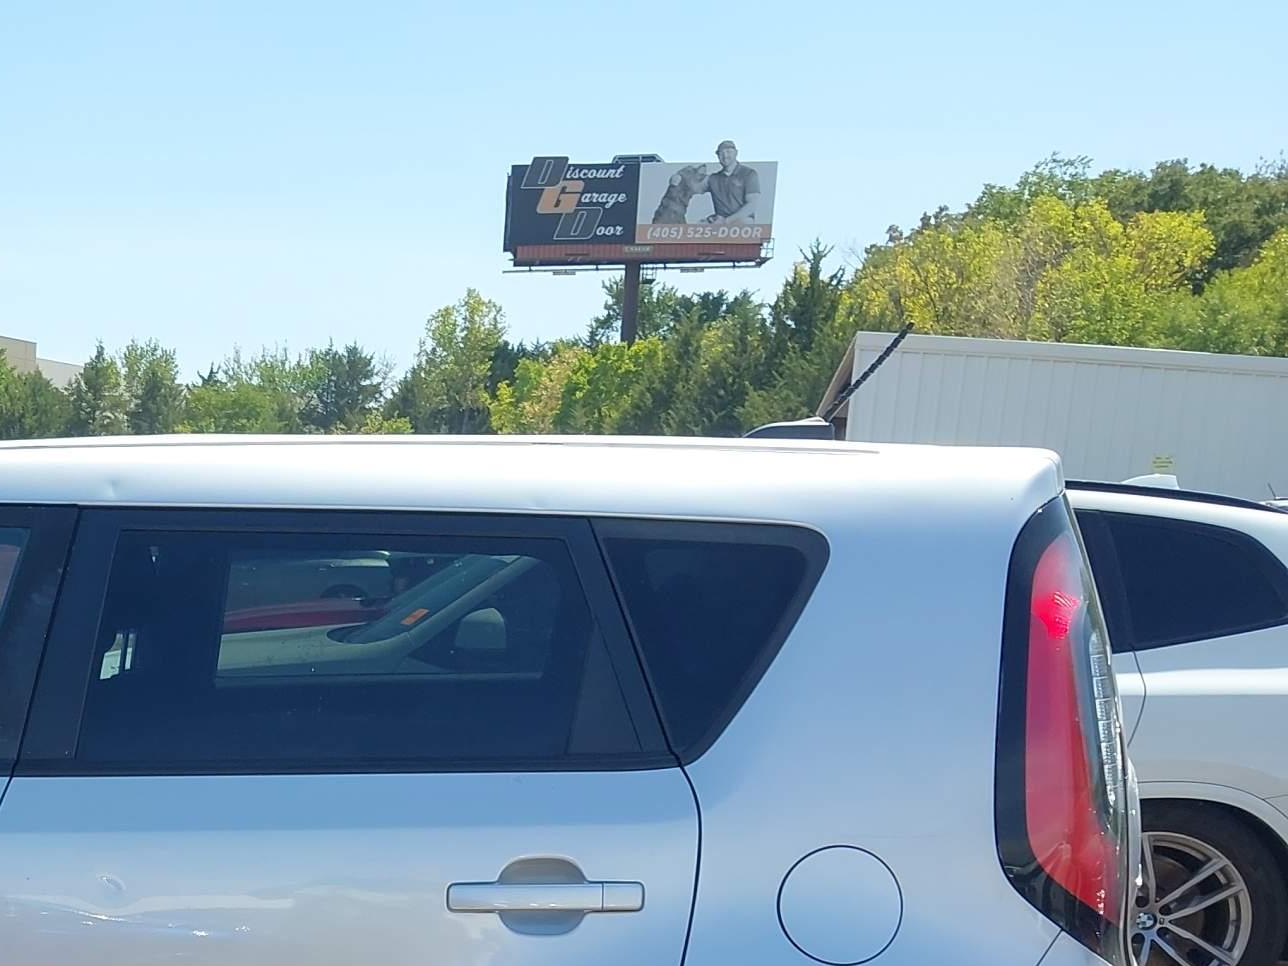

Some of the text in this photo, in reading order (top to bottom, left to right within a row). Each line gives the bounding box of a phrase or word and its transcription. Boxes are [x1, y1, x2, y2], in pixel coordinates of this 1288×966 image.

[520, 156, 625, 189] Discount
[536, 180, 627, 214] Garage
[552, 206, 624, 240] Door
[647, 225, 763, 239] (405) 525-DOOR
